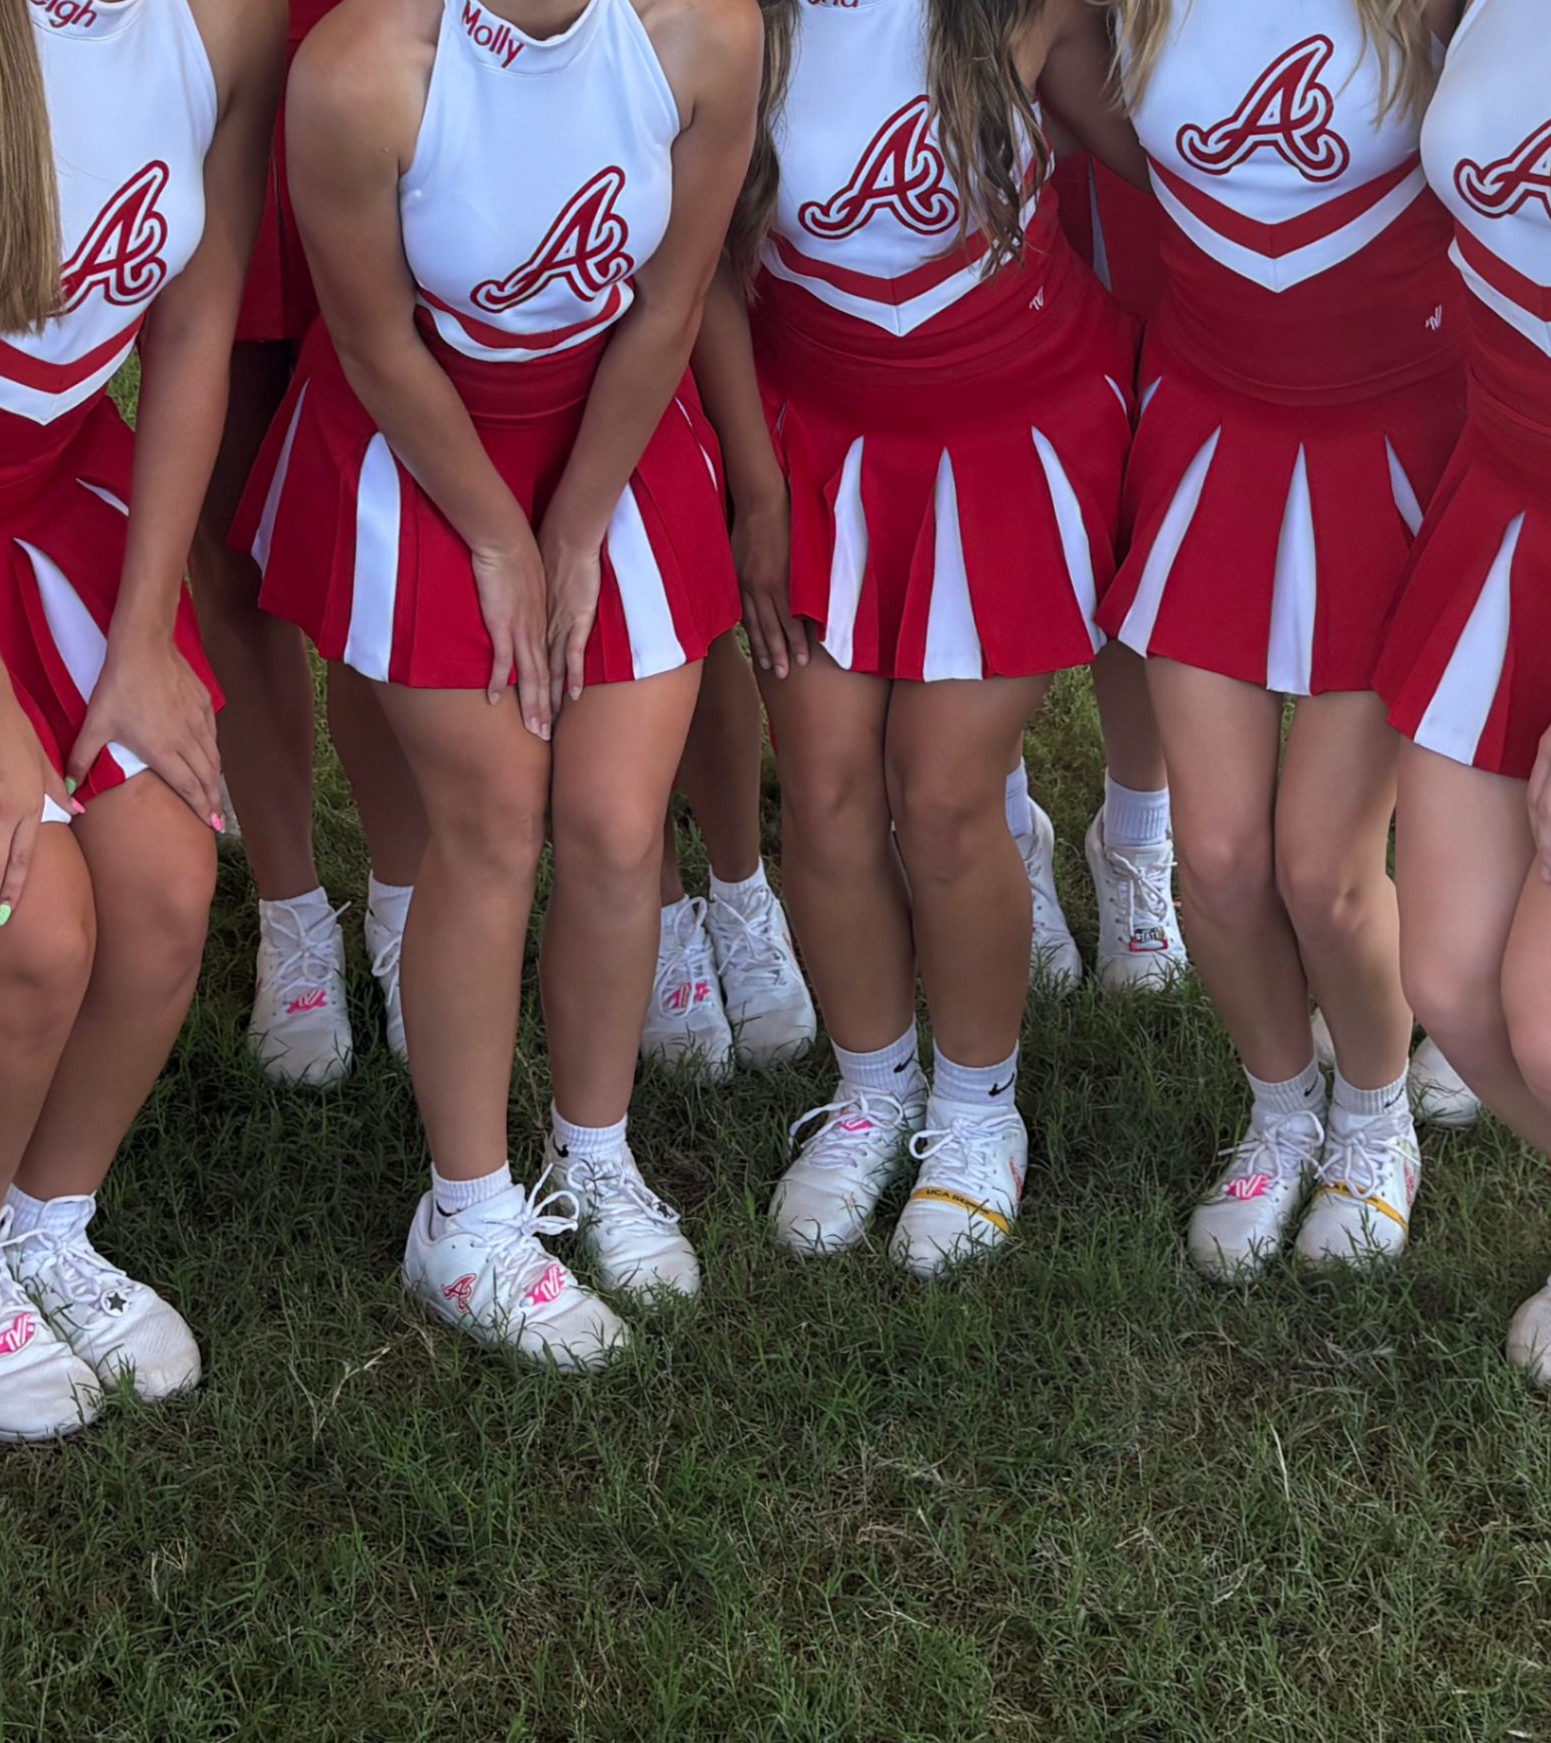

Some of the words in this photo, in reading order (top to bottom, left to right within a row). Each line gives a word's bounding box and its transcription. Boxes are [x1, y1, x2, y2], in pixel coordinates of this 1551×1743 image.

[798, 94, 960, 240] A
[1176, 34, 1350, 182] A
[46, 159, 169, 318] A
[469, 165, 635, 314] A
